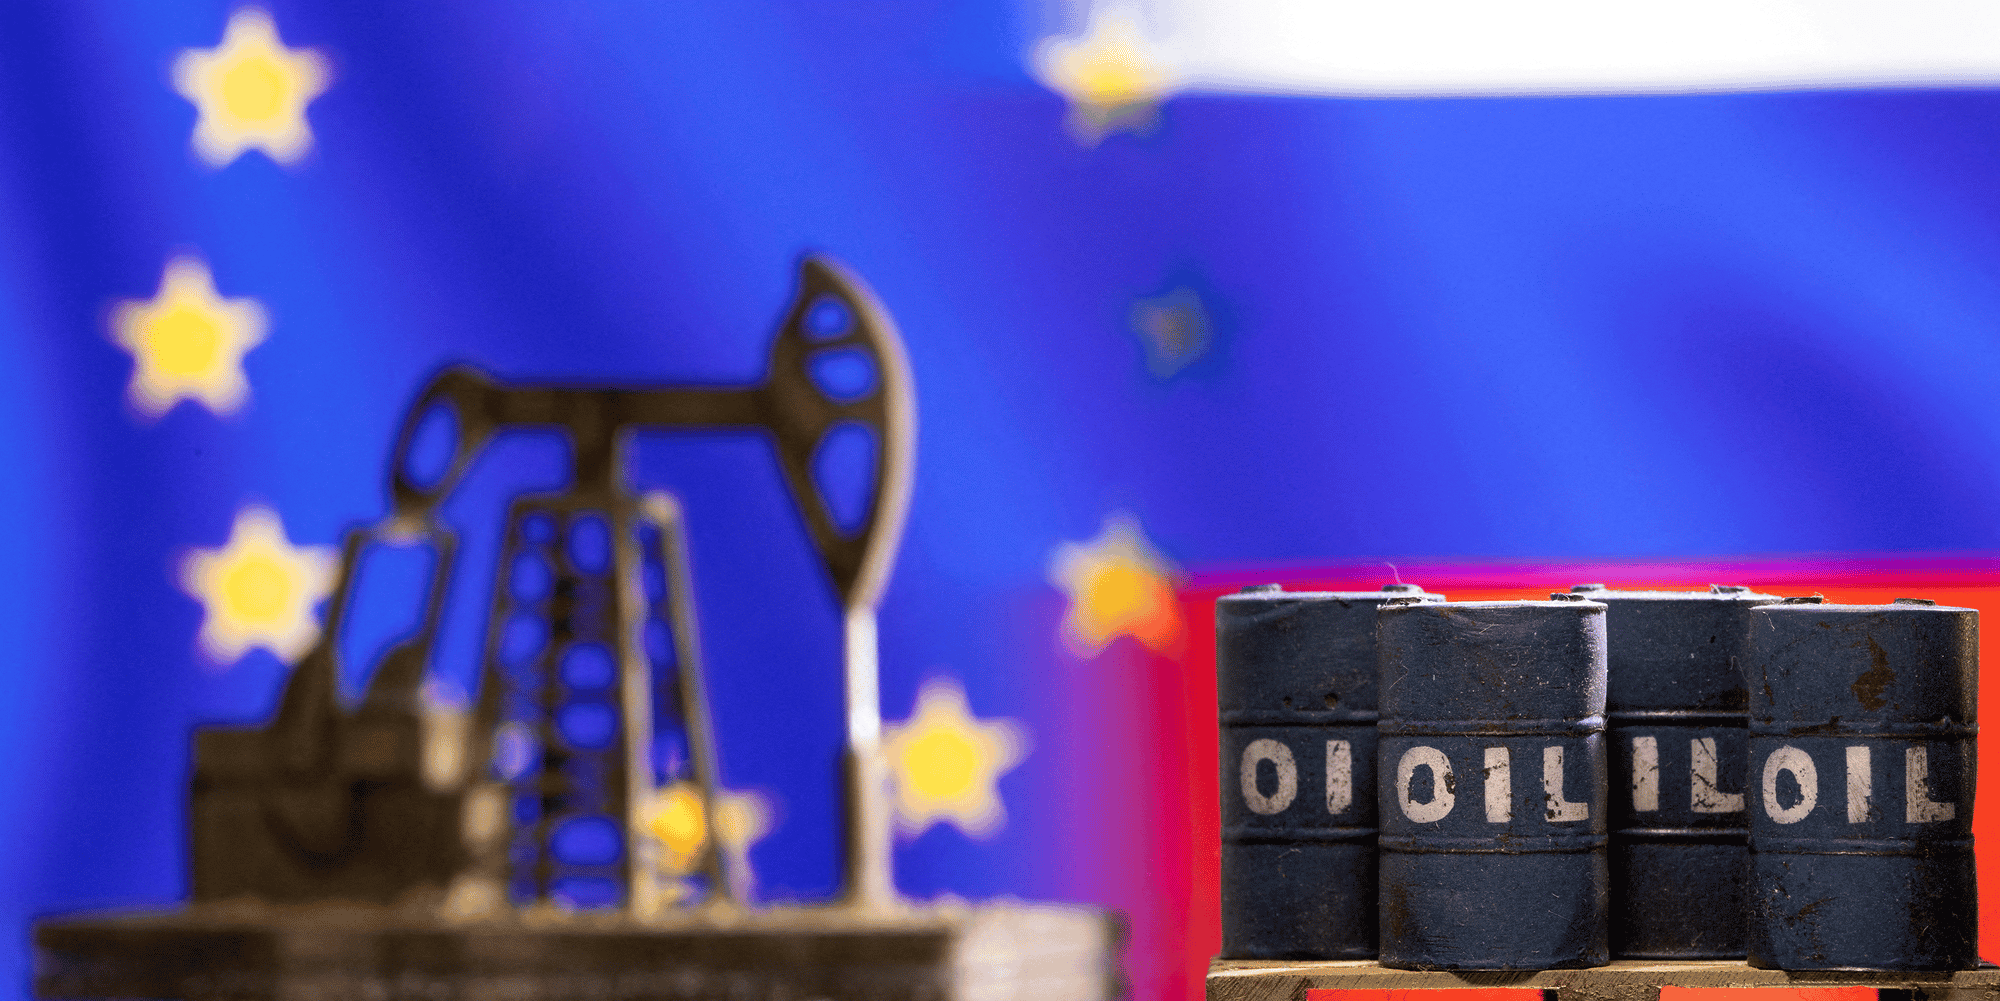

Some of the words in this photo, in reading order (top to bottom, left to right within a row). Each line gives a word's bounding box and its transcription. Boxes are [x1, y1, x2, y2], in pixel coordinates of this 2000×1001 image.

[1240, 738, 1352, 815] OI
[1397, 745, 1590, 823] OIL
[1632, 736, 1745, 814] IL
[1762, 745, 1956, 824] OIL
